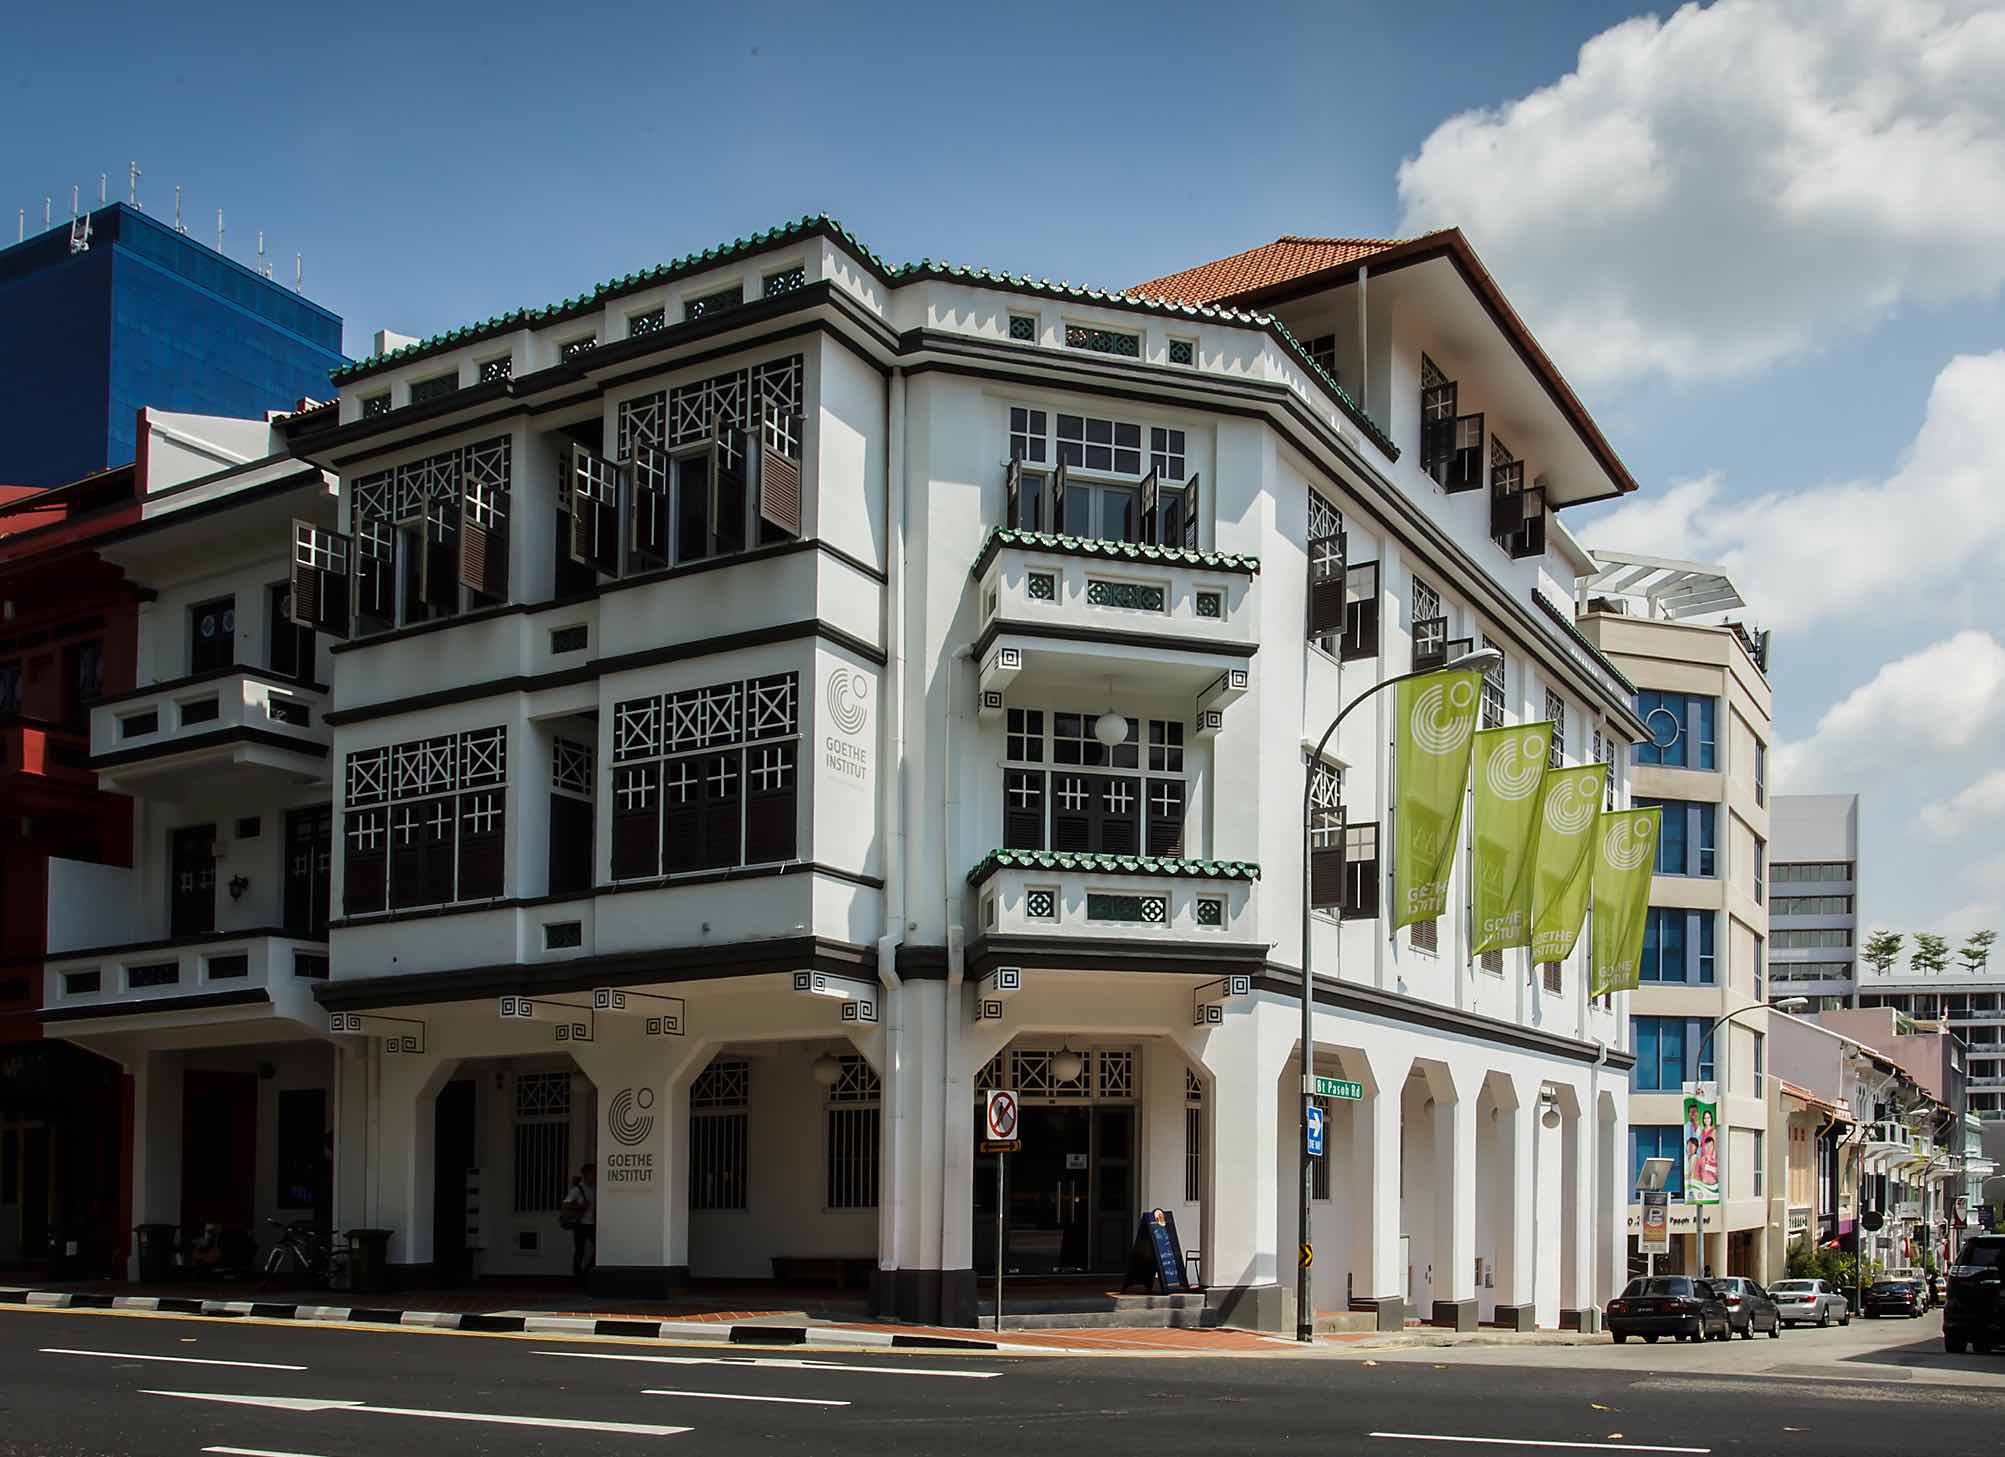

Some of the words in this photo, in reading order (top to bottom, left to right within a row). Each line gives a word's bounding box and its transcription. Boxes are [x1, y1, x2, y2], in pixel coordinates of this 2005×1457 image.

[826, 736, 867, 764] GOETHE
[826, 753, 867, 780] INSTITUT
[1317, 1079, 1325, 1093] Bt
[1328, 1081, 1349, 1096] Pasoh
[1351, 1084, 1360, 1098] Rd
[608, 1154, 653, 1167] GOETHE
[608, 1169, 653, 1182] INSTITUT
